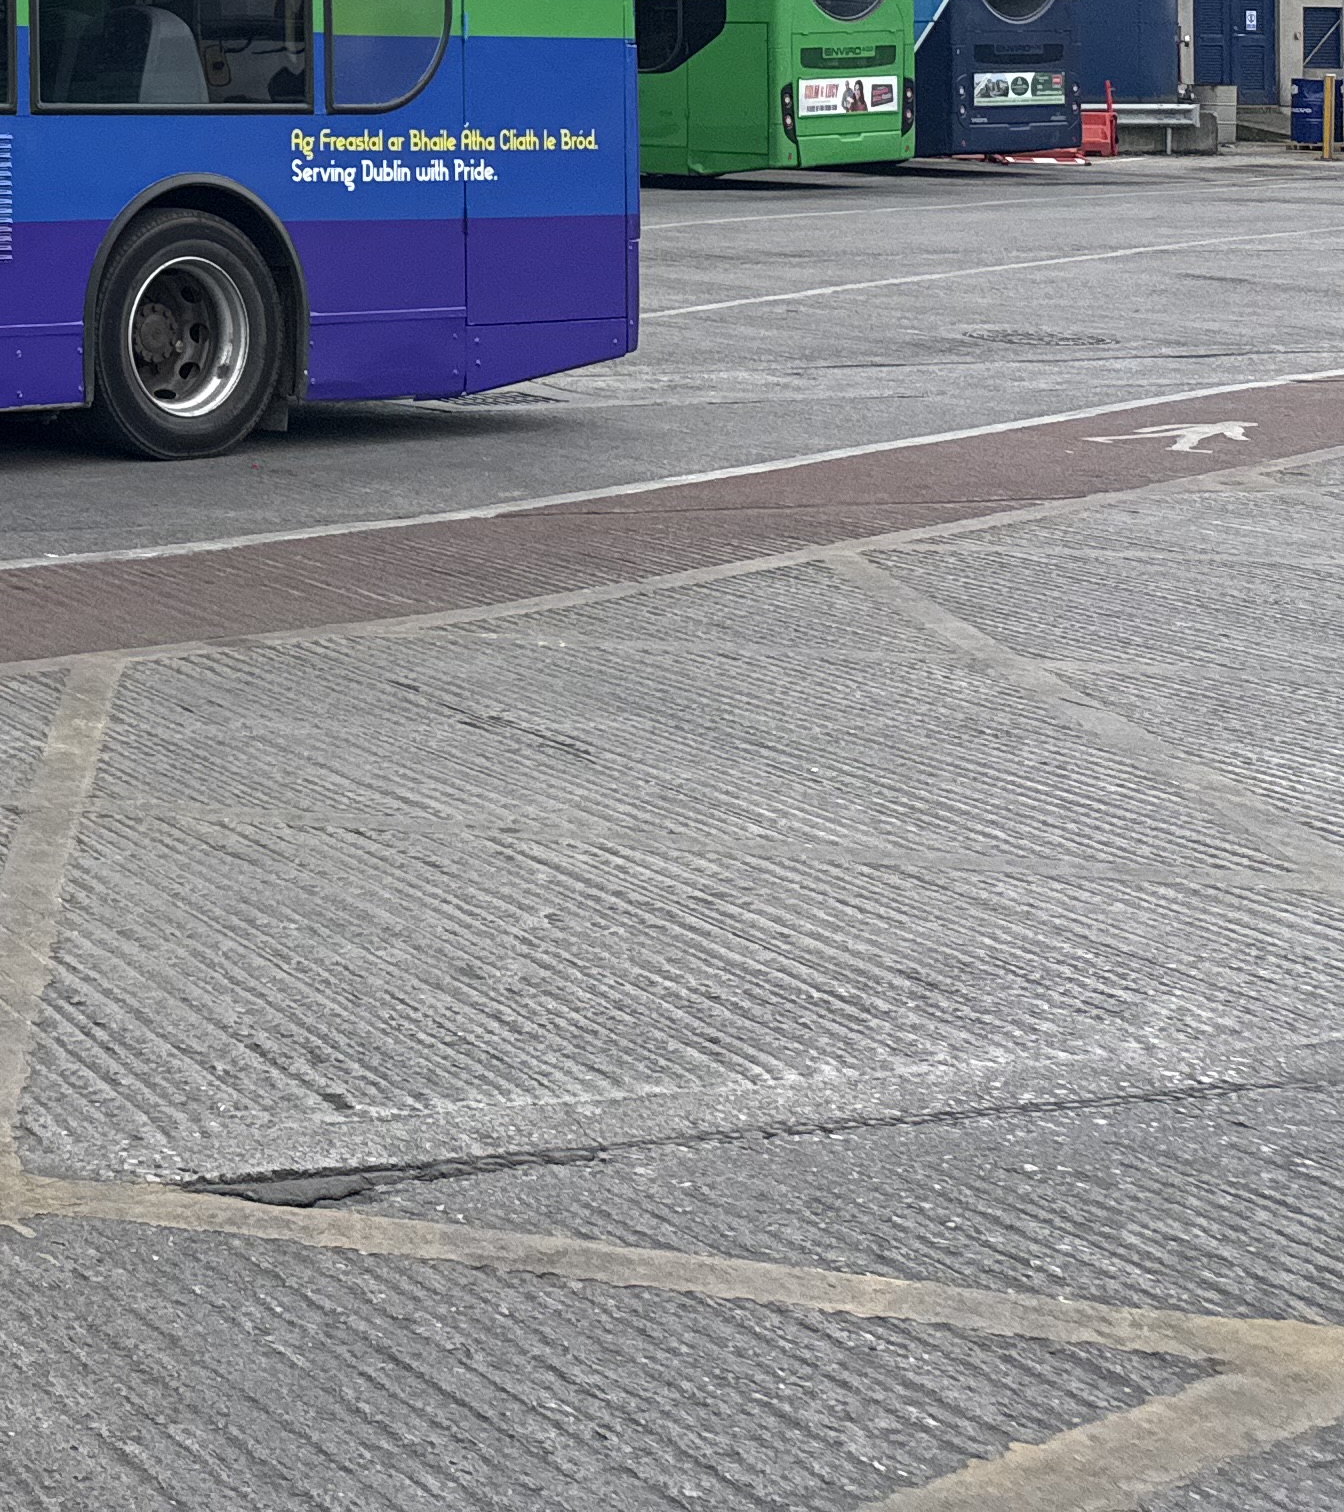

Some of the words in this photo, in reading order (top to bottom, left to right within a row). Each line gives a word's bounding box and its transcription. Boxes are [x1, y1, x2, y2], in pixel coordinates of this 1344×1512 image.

[291, 129, 315, 160] Ag
[319, 129, 384, 152] Freastal
[387, 134, 404, 151] ar
[409, 129, 457, 152] Bhaile
[460, 121, 495, 151] Átha
[499, 128, 540, 151] Cliath
[543, 128, 556, 151] le
[291, 159, 356, 191] Serving
[361, 159, 411, 182] Dublin
[415, 159, 450, 181] with
[454, 157, 499, 181] Pride.
